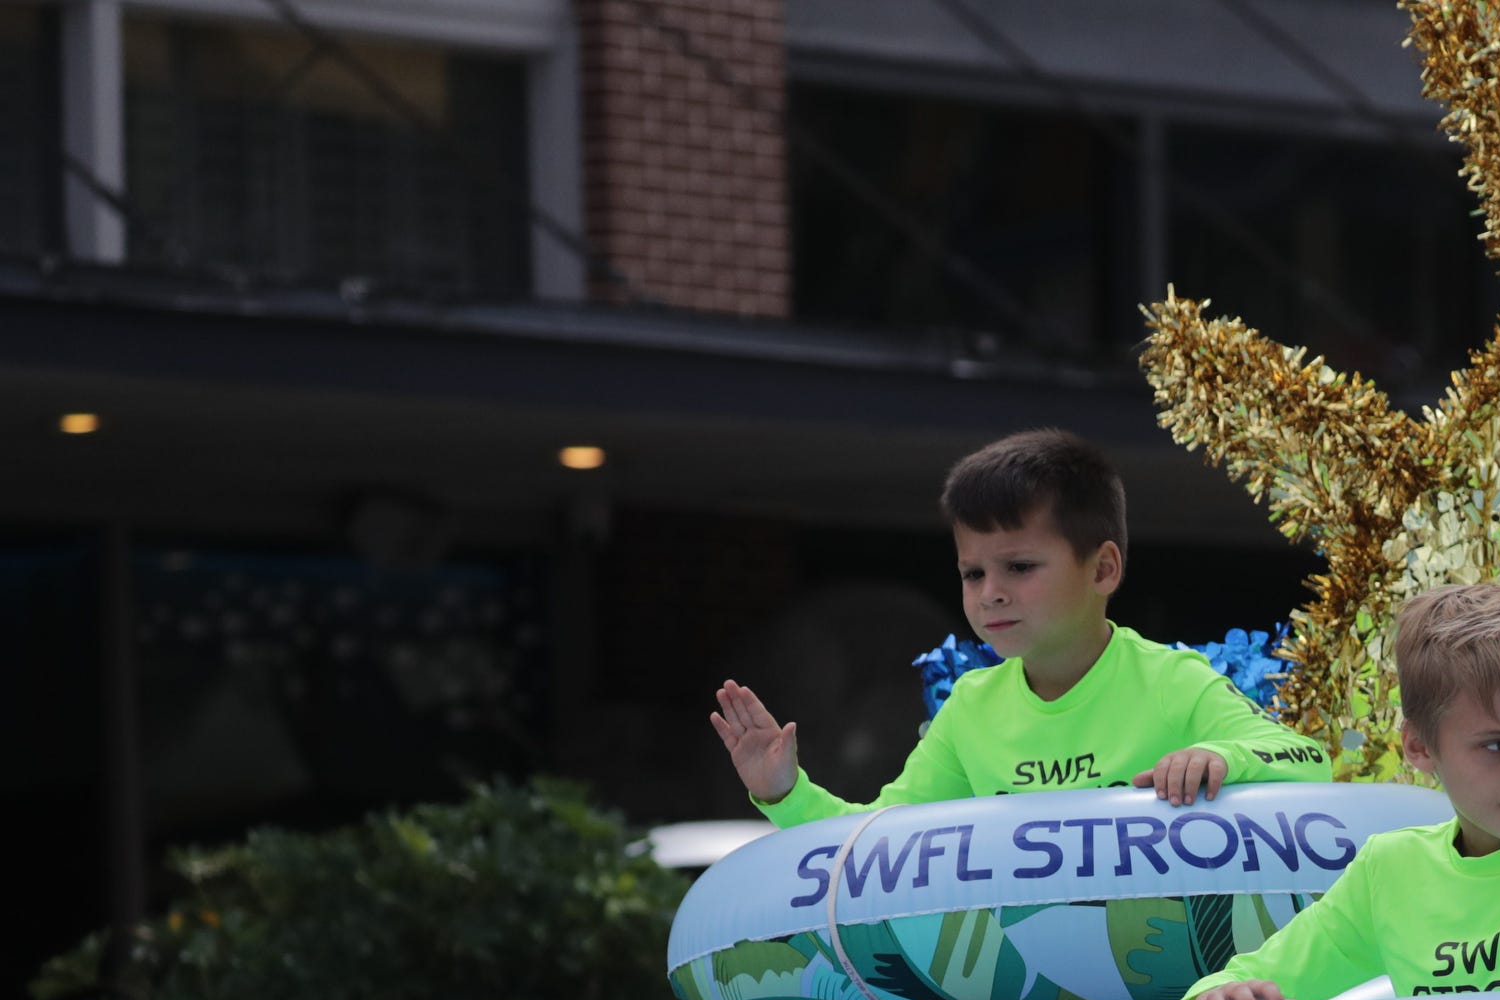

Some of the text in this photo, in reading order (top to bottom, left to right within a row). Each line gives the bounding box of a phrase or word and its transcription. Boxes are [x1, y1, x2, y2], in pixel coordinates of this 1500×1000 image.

[1012, 752, 1101, 785] SWFL
[790, 811, 1357, 908] SWFL STRONG
